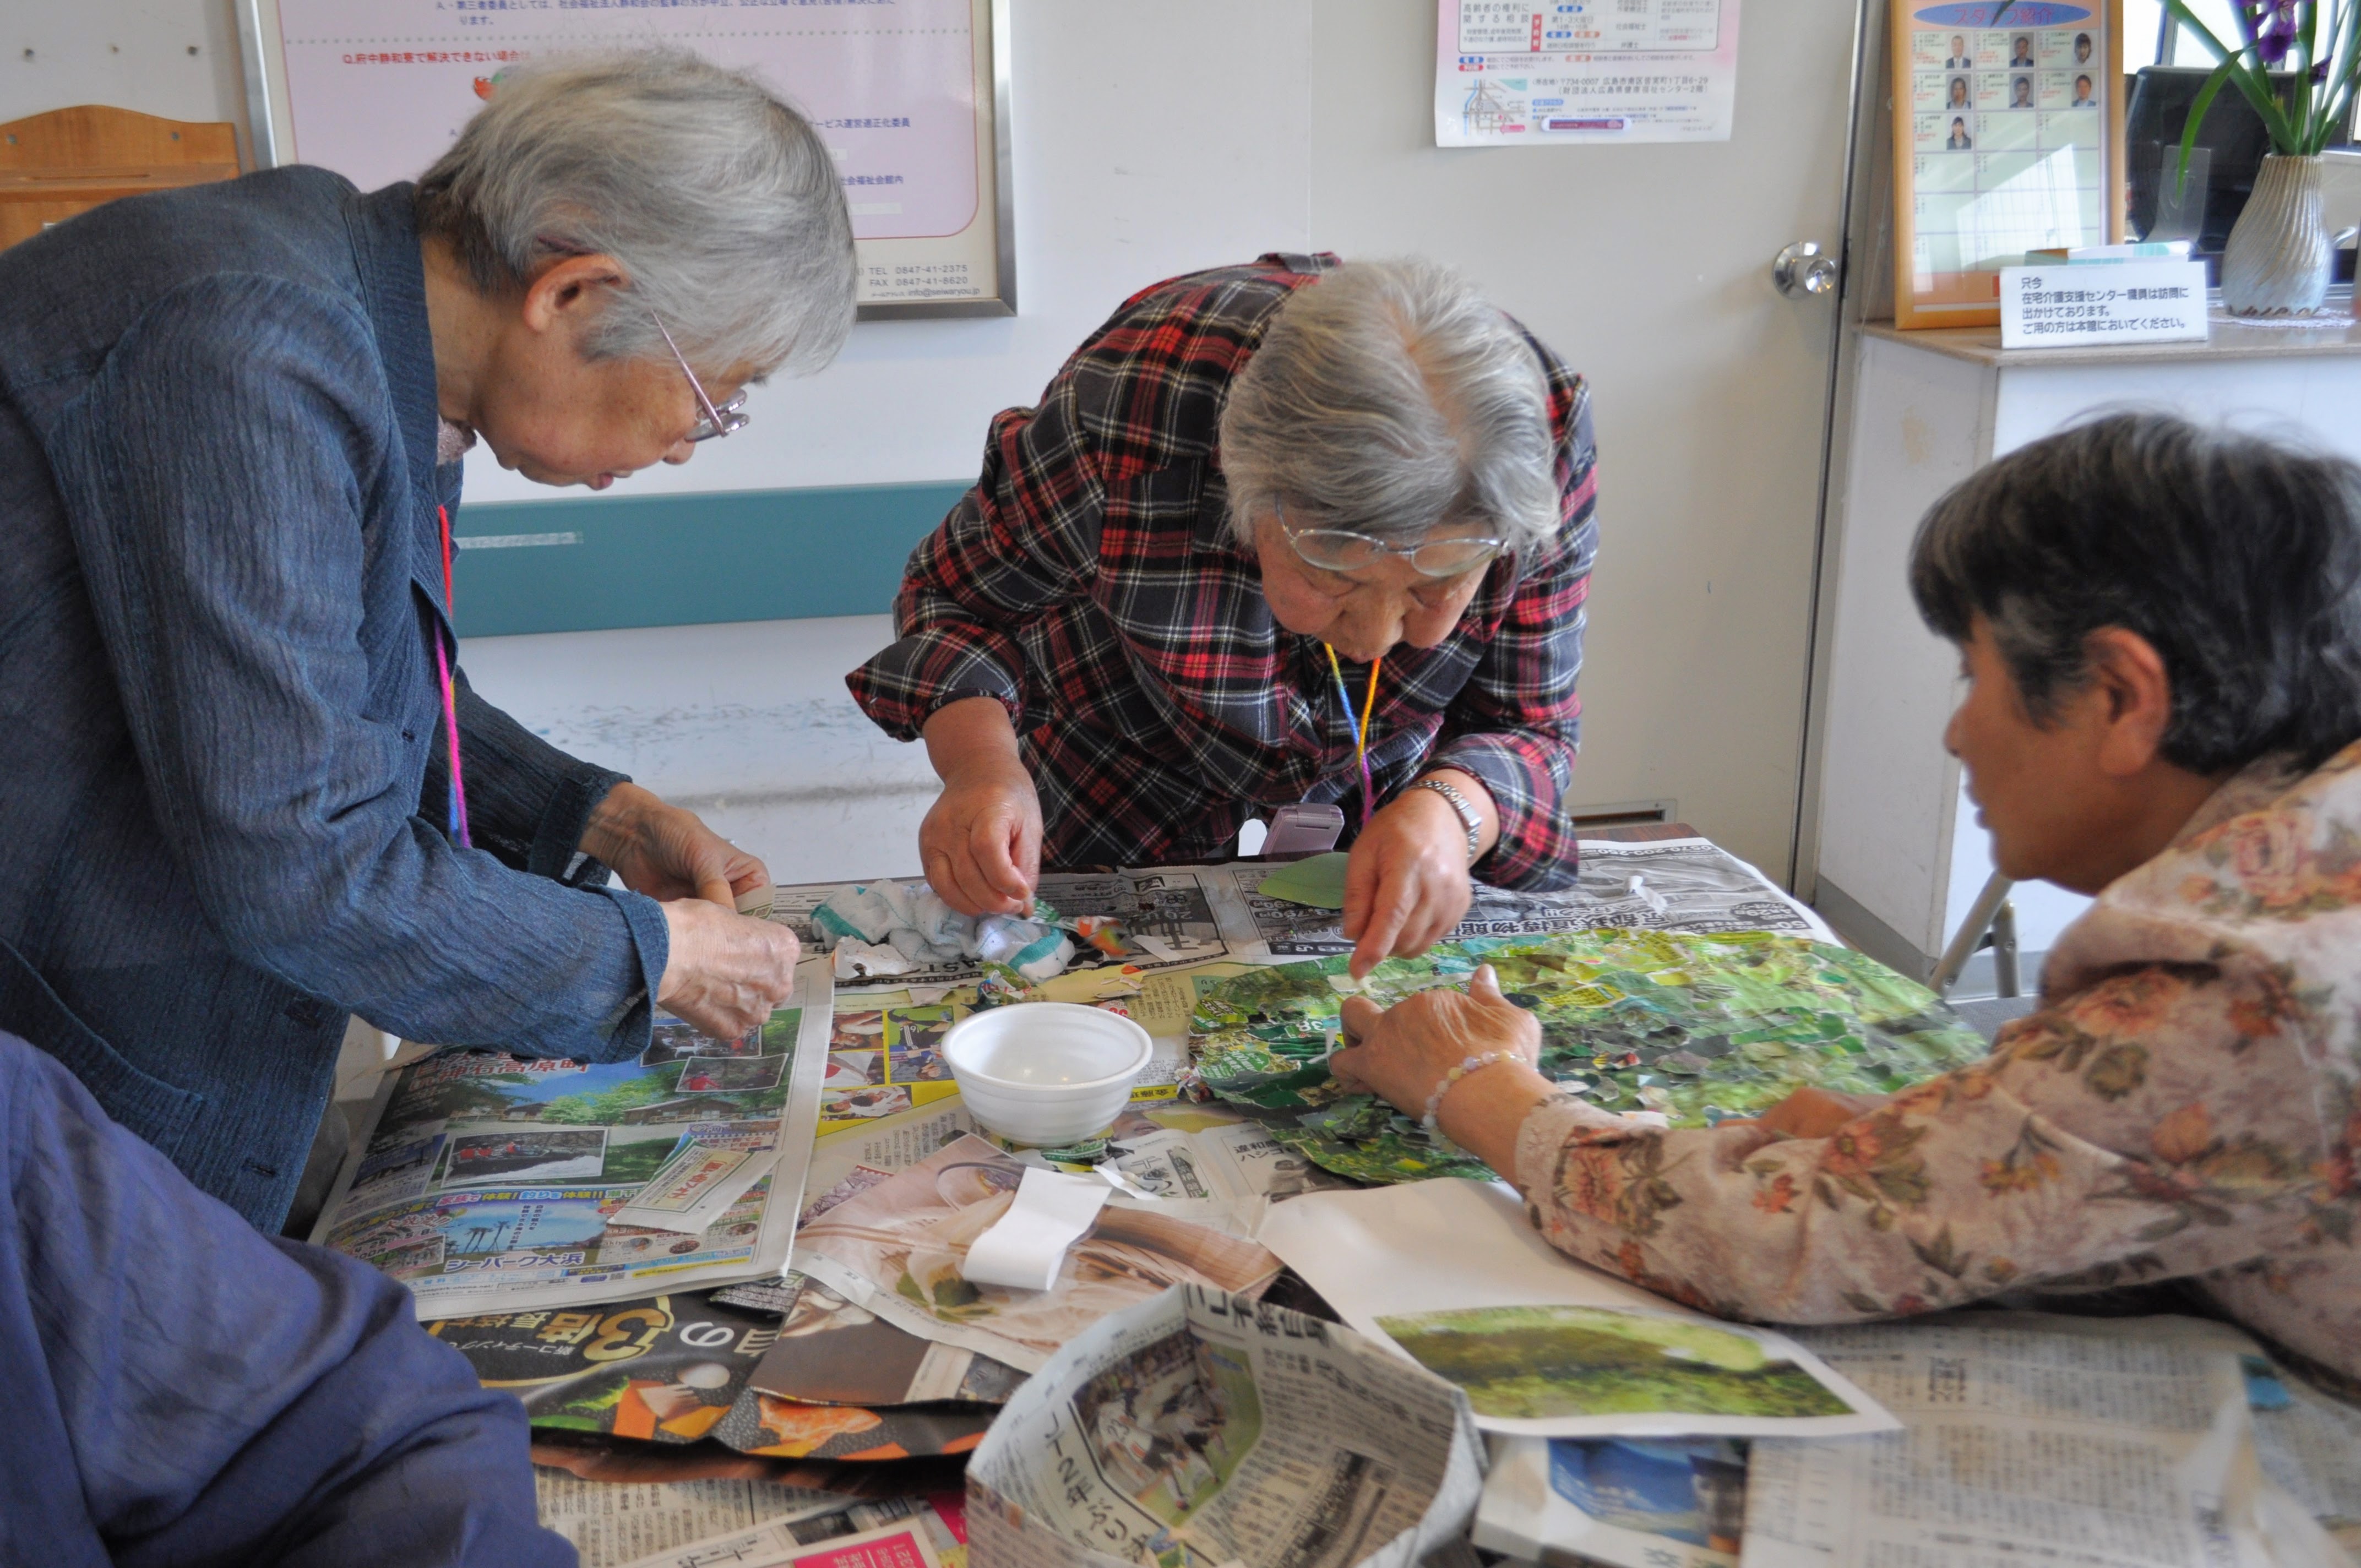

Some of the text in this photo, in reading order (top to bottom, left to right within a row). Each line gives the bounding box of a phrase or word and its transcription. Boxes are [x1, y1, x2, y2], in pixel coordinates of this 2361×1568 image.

[1463, 3, 1530, 13] 高齢者の権利に
[459, 15, 494, 25] ります。
[869, 264, 968, 275] TEL 0847-41-2375
[869, 276, 968, 287] FAX 0847-41-8620
[2021, 277, 2042, 290] 只今
[2021, 287, 2189, 304] 在宅介護支援センター職員は訪問に
[2022, 305, 2110, 320] 出かけております。
[2023, 317, 2186, 335] ご用の方は本館においでください。
[1461, 911, 1667, 935] 京都鉄道博物館
[605, 1188, 643, 1199] 潮干
[446, 1252, 584, 1272] シーパーク大浜
